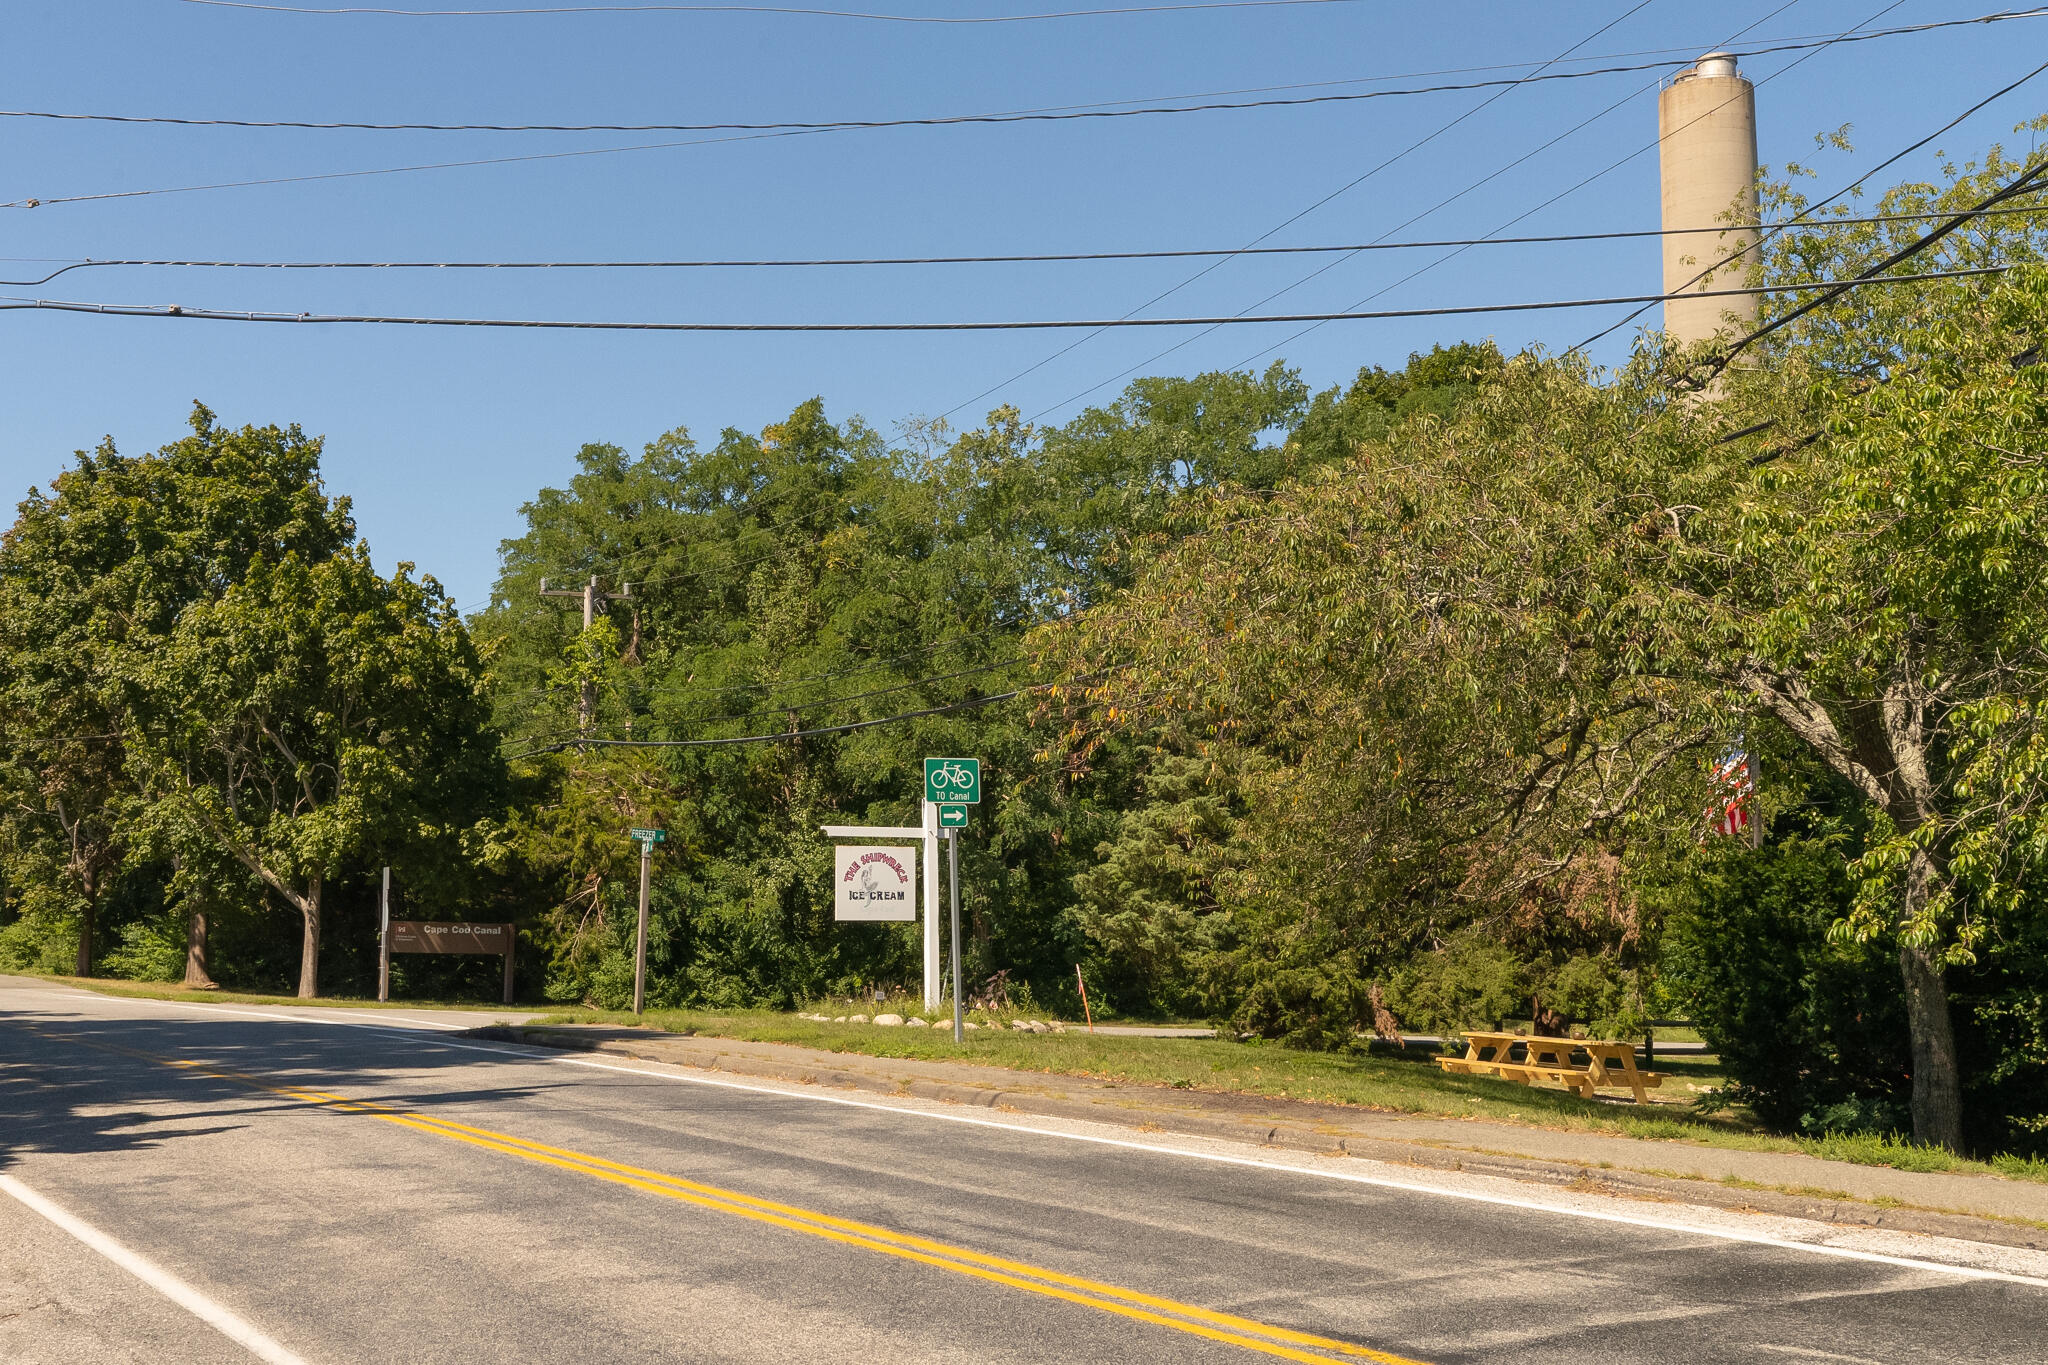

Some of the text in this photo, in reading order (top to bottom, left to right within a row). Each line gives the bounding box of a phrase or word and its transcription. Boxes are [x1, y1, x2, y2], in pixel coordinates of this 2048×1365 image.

[936, 791, 970, 800] TO Canal
[632, 829, 656, 840] FREEZER
[844, 852, 908, 884] THE SHIPWRECK
[849, 890, 905, 901] ICE CREAM
[424, 925, 502, 936] Cape Cod Canal
